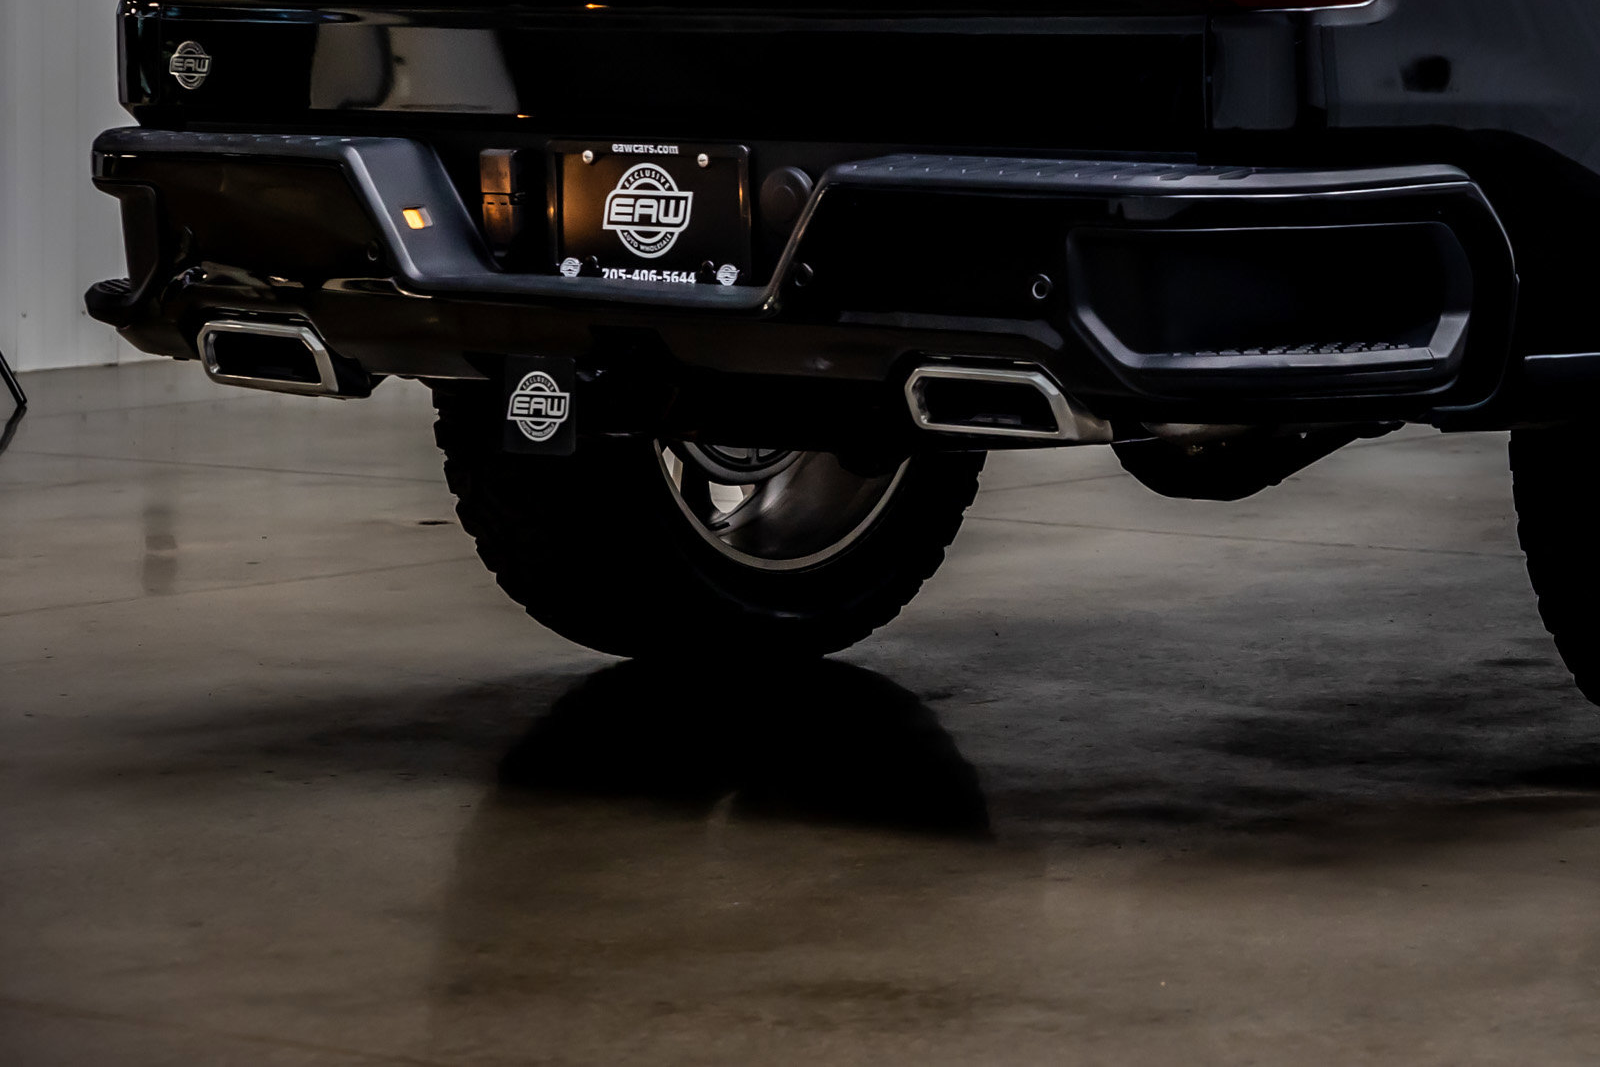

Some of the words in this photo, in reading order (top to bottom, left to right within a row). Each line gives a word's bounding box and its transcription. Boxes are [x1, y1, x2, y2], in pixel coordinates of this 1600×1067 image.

[171, 57, 210, 73] EAW
[611, 143, 679, 155] eawcars.com
[624, 169, 671, 190] EXCLUSIVE
[609, 197, 686, 225] EAW
[623, 232, 639, 248] AUTO
[640, 232, 673, 253] WHOLESALE
[601, 267, 697, 284] 205-406-5644
[512, 396, 565, 417] EAW
